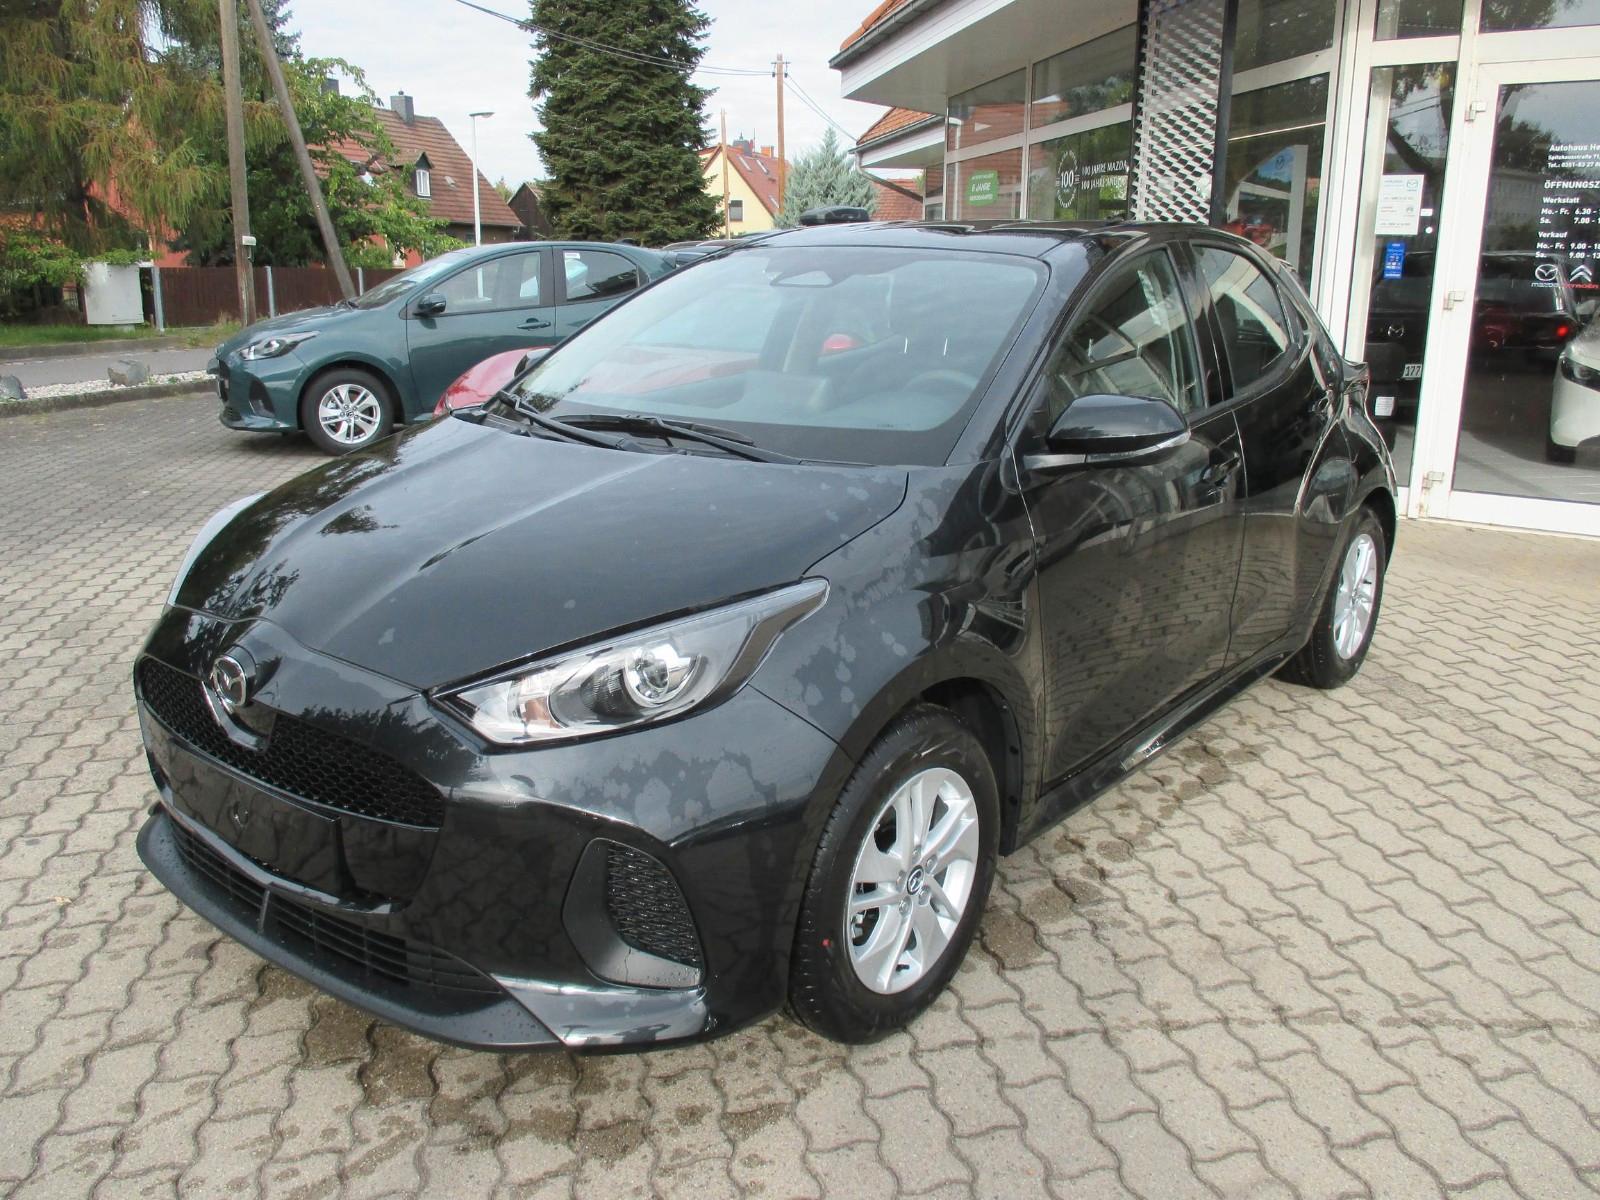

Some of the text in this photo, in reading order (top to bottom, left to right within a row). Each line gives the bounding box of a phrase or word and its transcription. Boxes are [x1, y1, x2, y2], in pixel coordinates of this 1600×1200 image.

[1549, 144, 1587, 152] Autohaus
[1091, 163, 1106, 176] JAHRE
[1061, 170, 1074, 188] 100
[1081, 180, 1090, 190] 100
